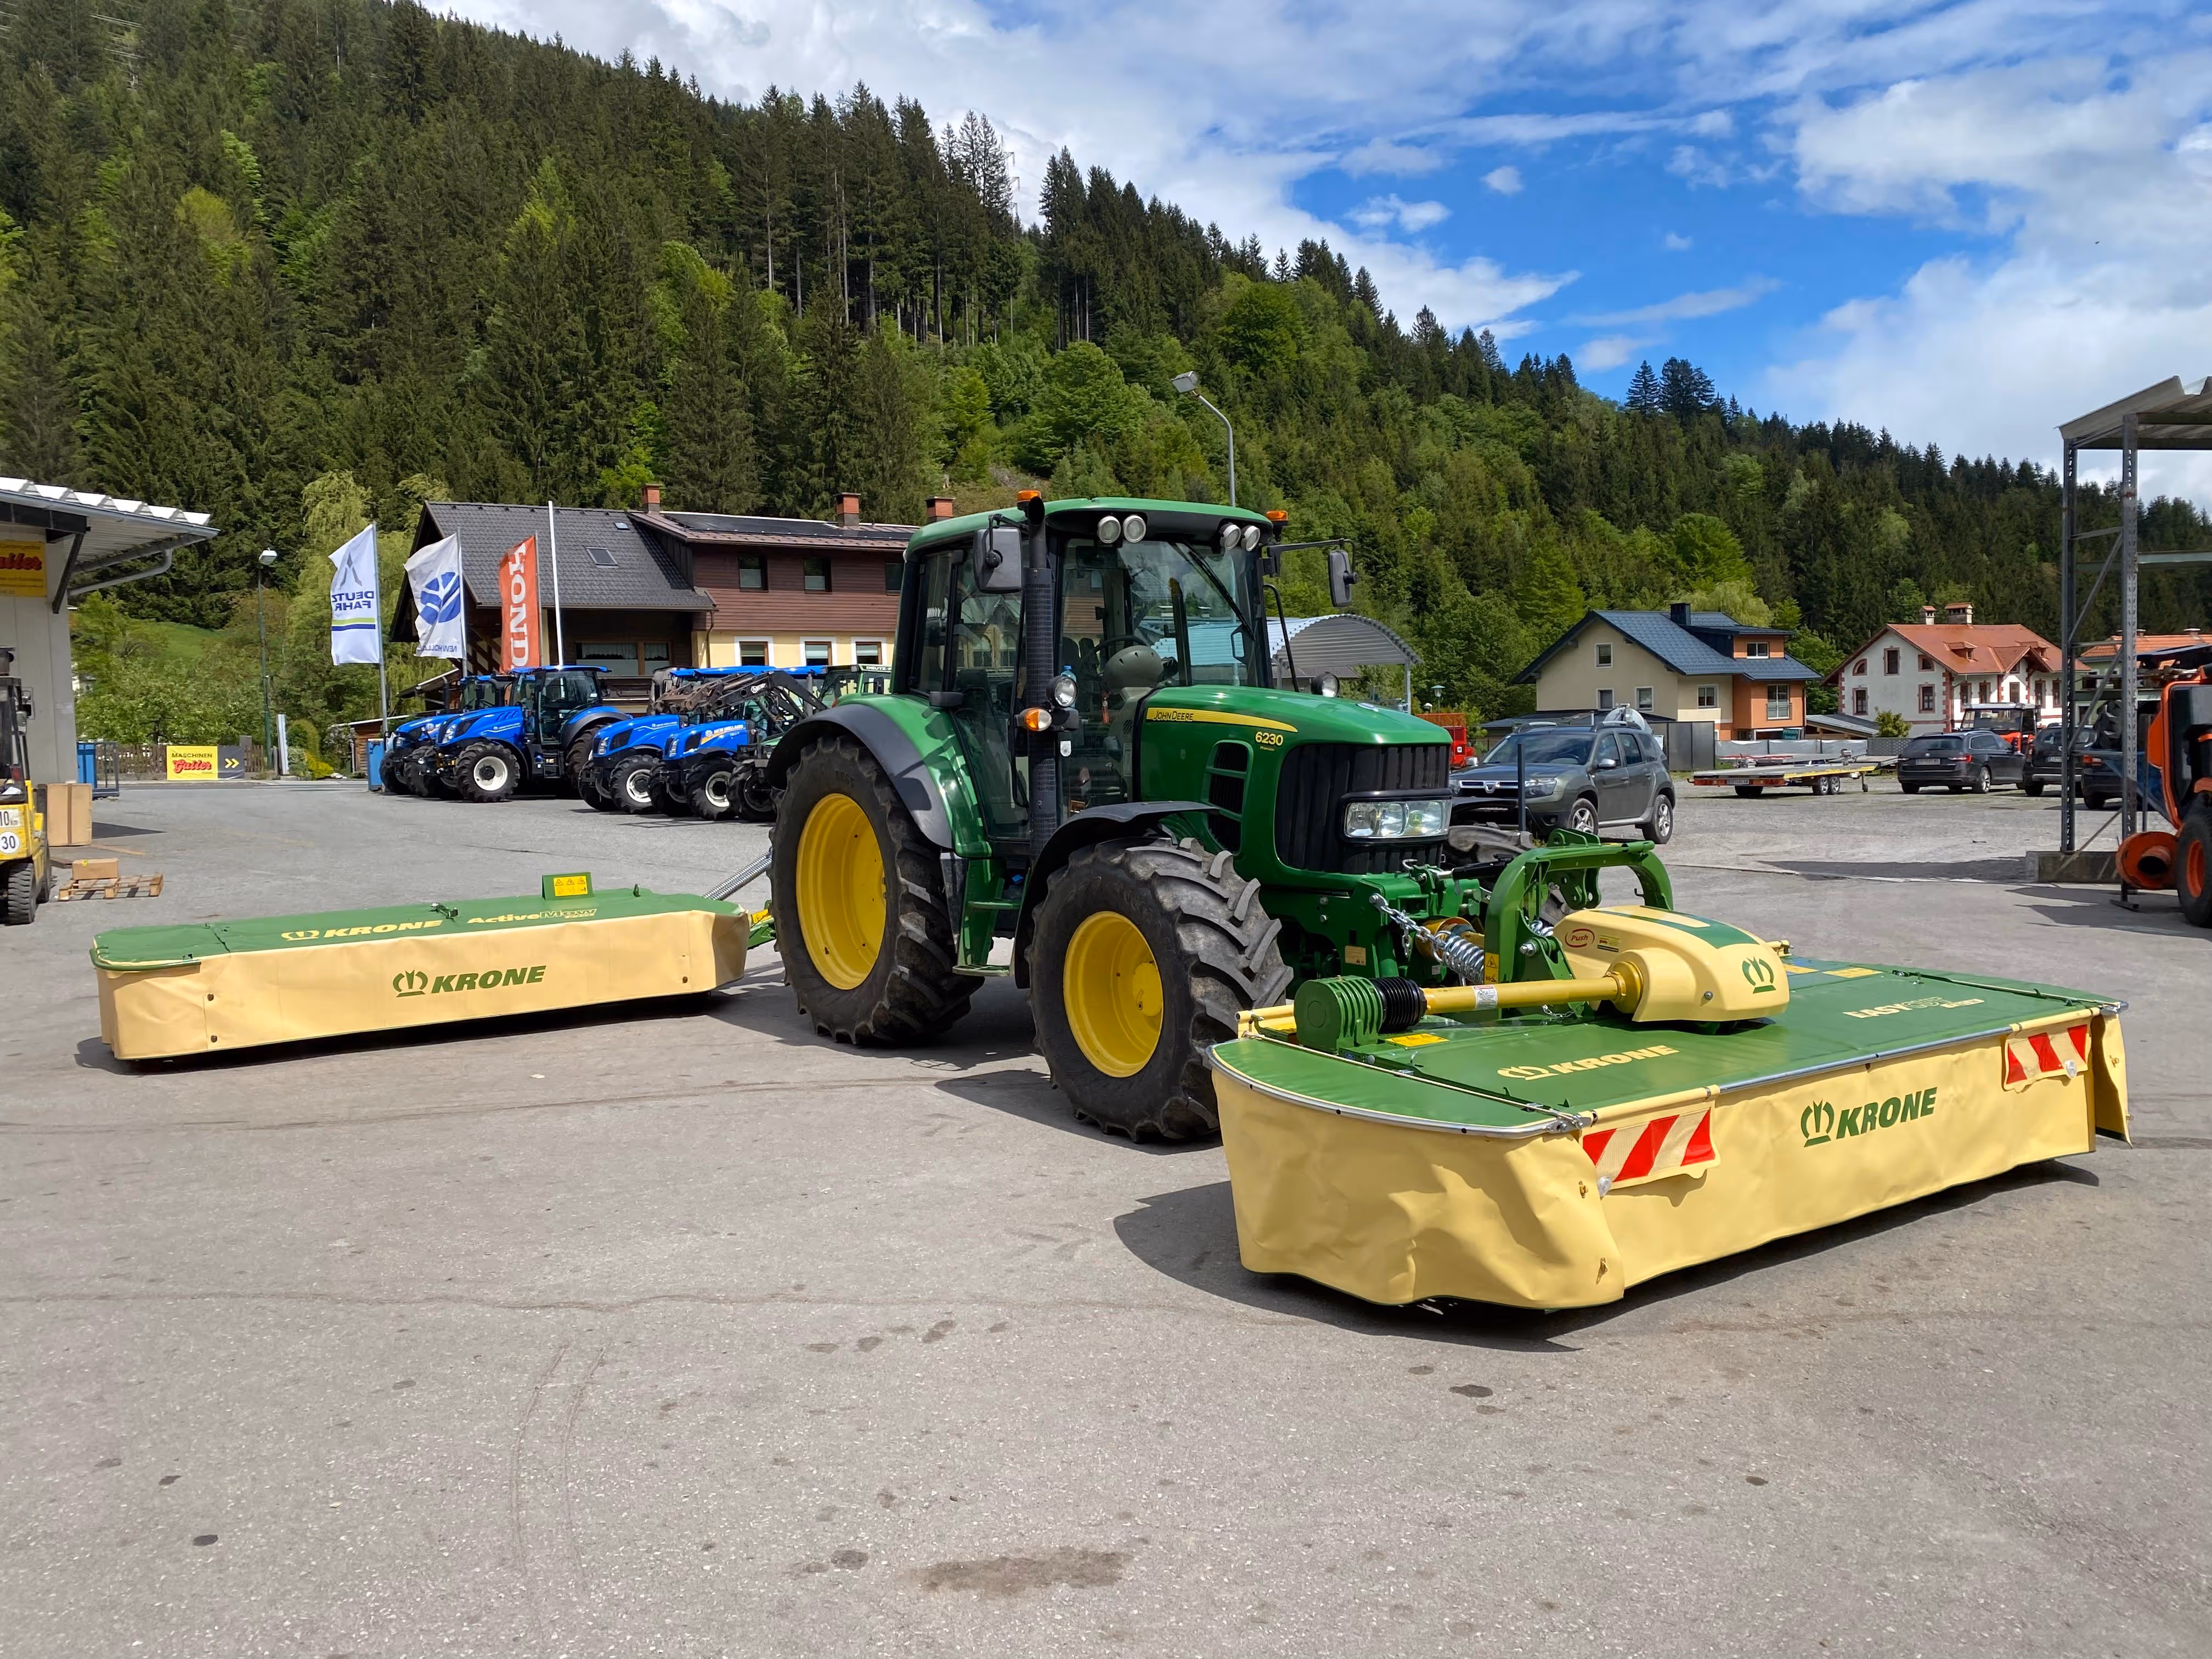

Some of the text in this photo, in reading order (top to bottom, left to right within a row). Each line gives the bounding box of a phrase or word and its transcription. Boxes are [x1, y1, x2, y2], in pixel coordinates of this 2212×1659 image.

[508, 543, 529, 669] HOND
[1154, 710, 1194, 721] JOHN DEERE
[1255, 731, 1284, 746] 6230
[1, 836, 15, 850] 30
[324, 920, 443, 938] KRONE
[431, 965, 546, 994] KRONE
[1548, 1045, 1680, 1074] KRONE
[1836, 1086, 1938, 1139] KRONE
